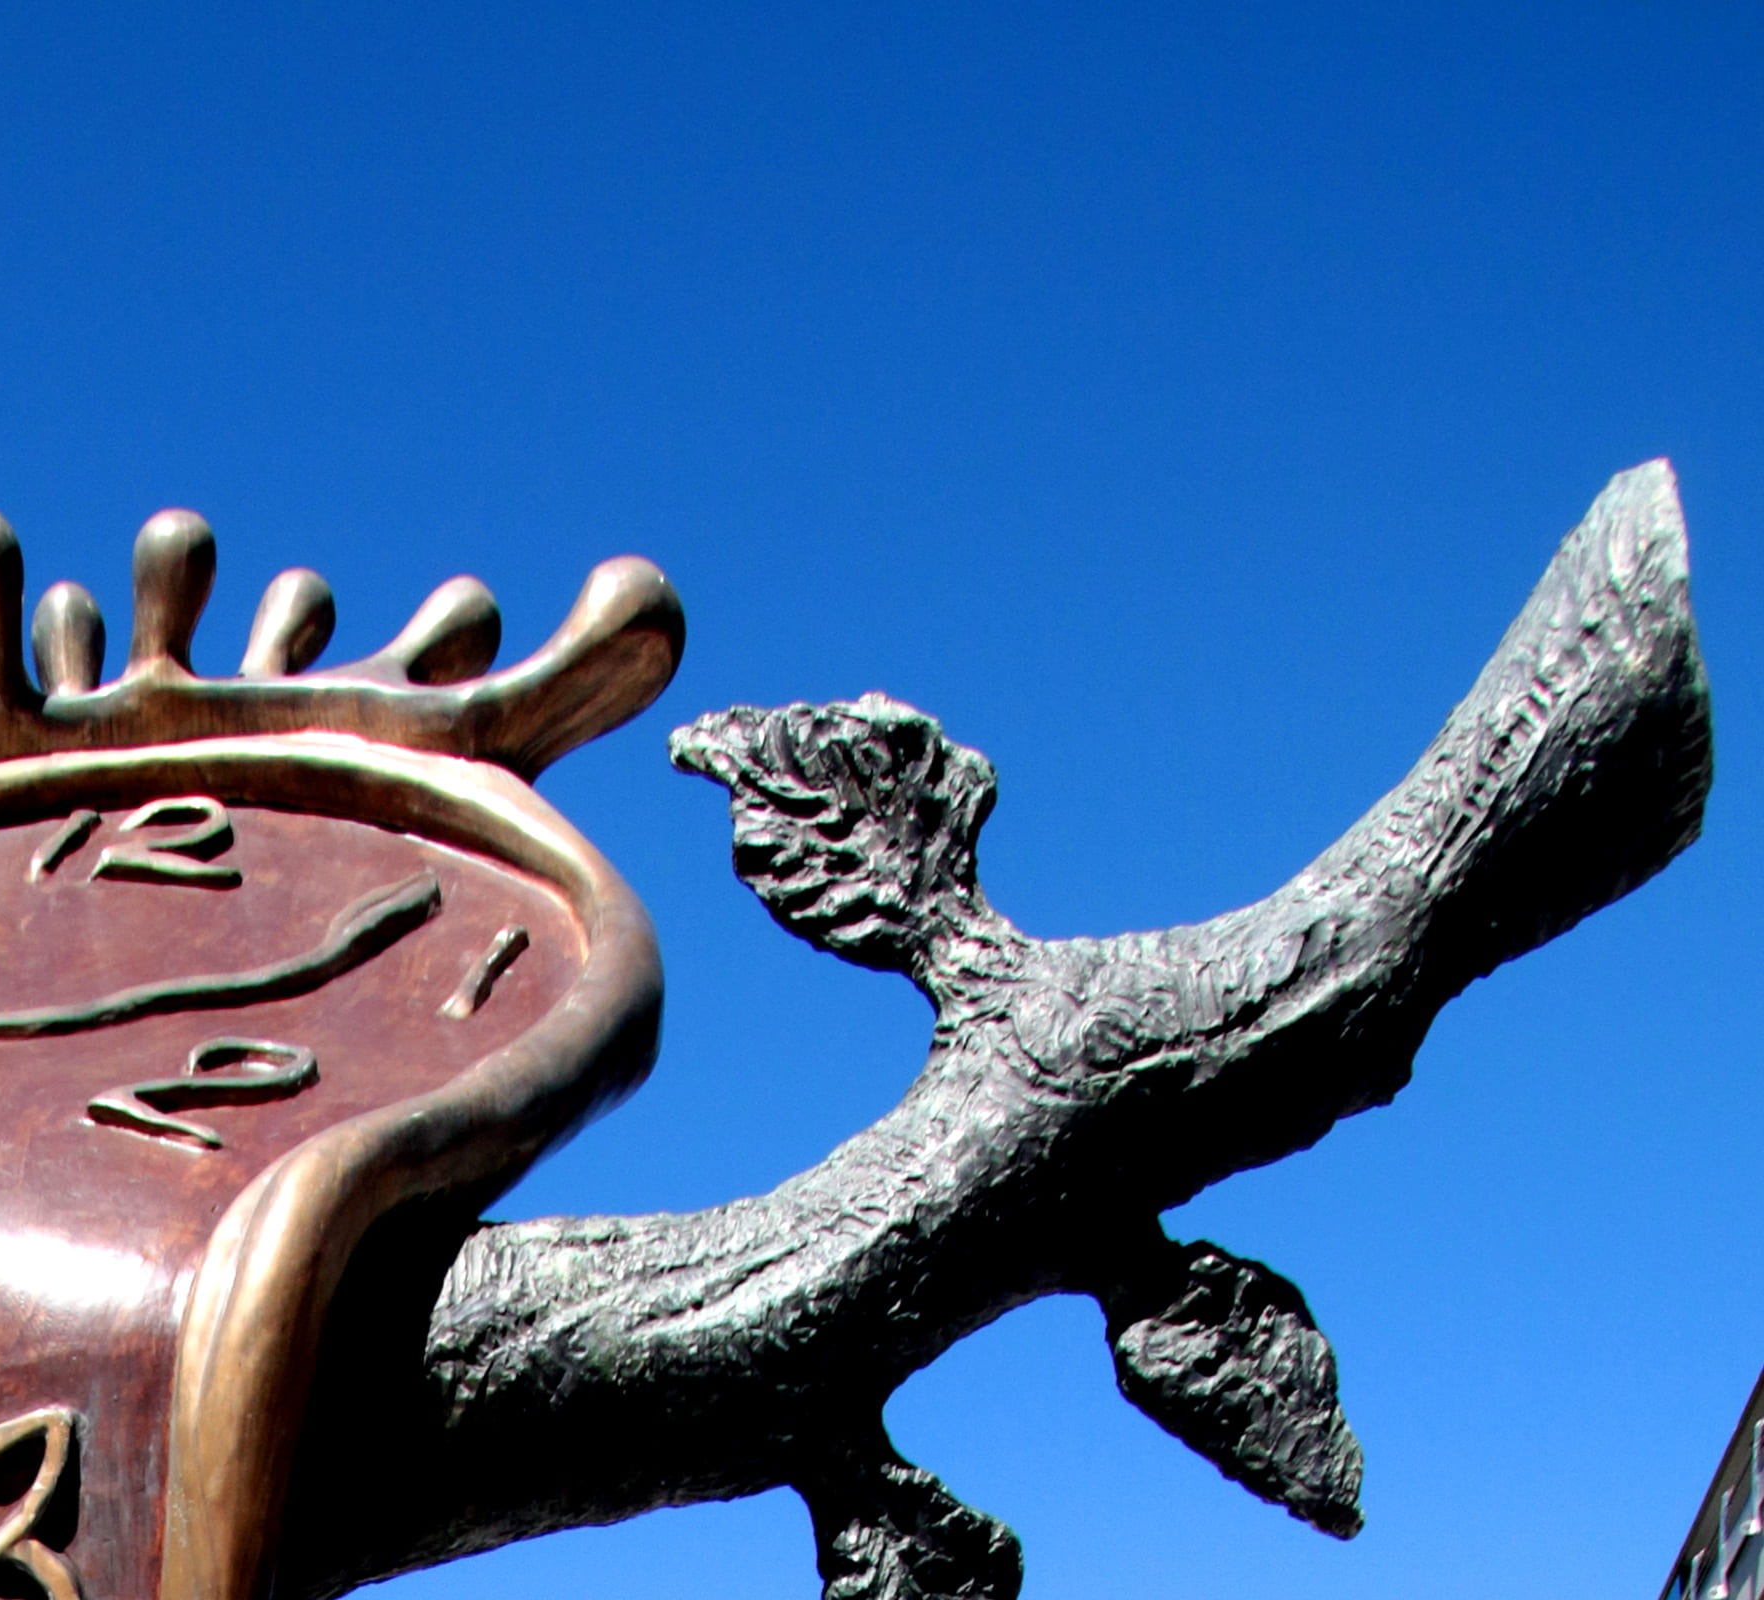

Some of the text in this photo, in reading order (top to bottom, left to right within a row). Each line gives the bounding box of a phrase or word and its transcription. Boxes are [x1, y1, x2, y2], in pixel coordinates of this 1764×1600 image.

[30, 796, 242, 888] 12
[441, 924, 529, 1020] 1
[86, 1034, 320, 1150] 2
